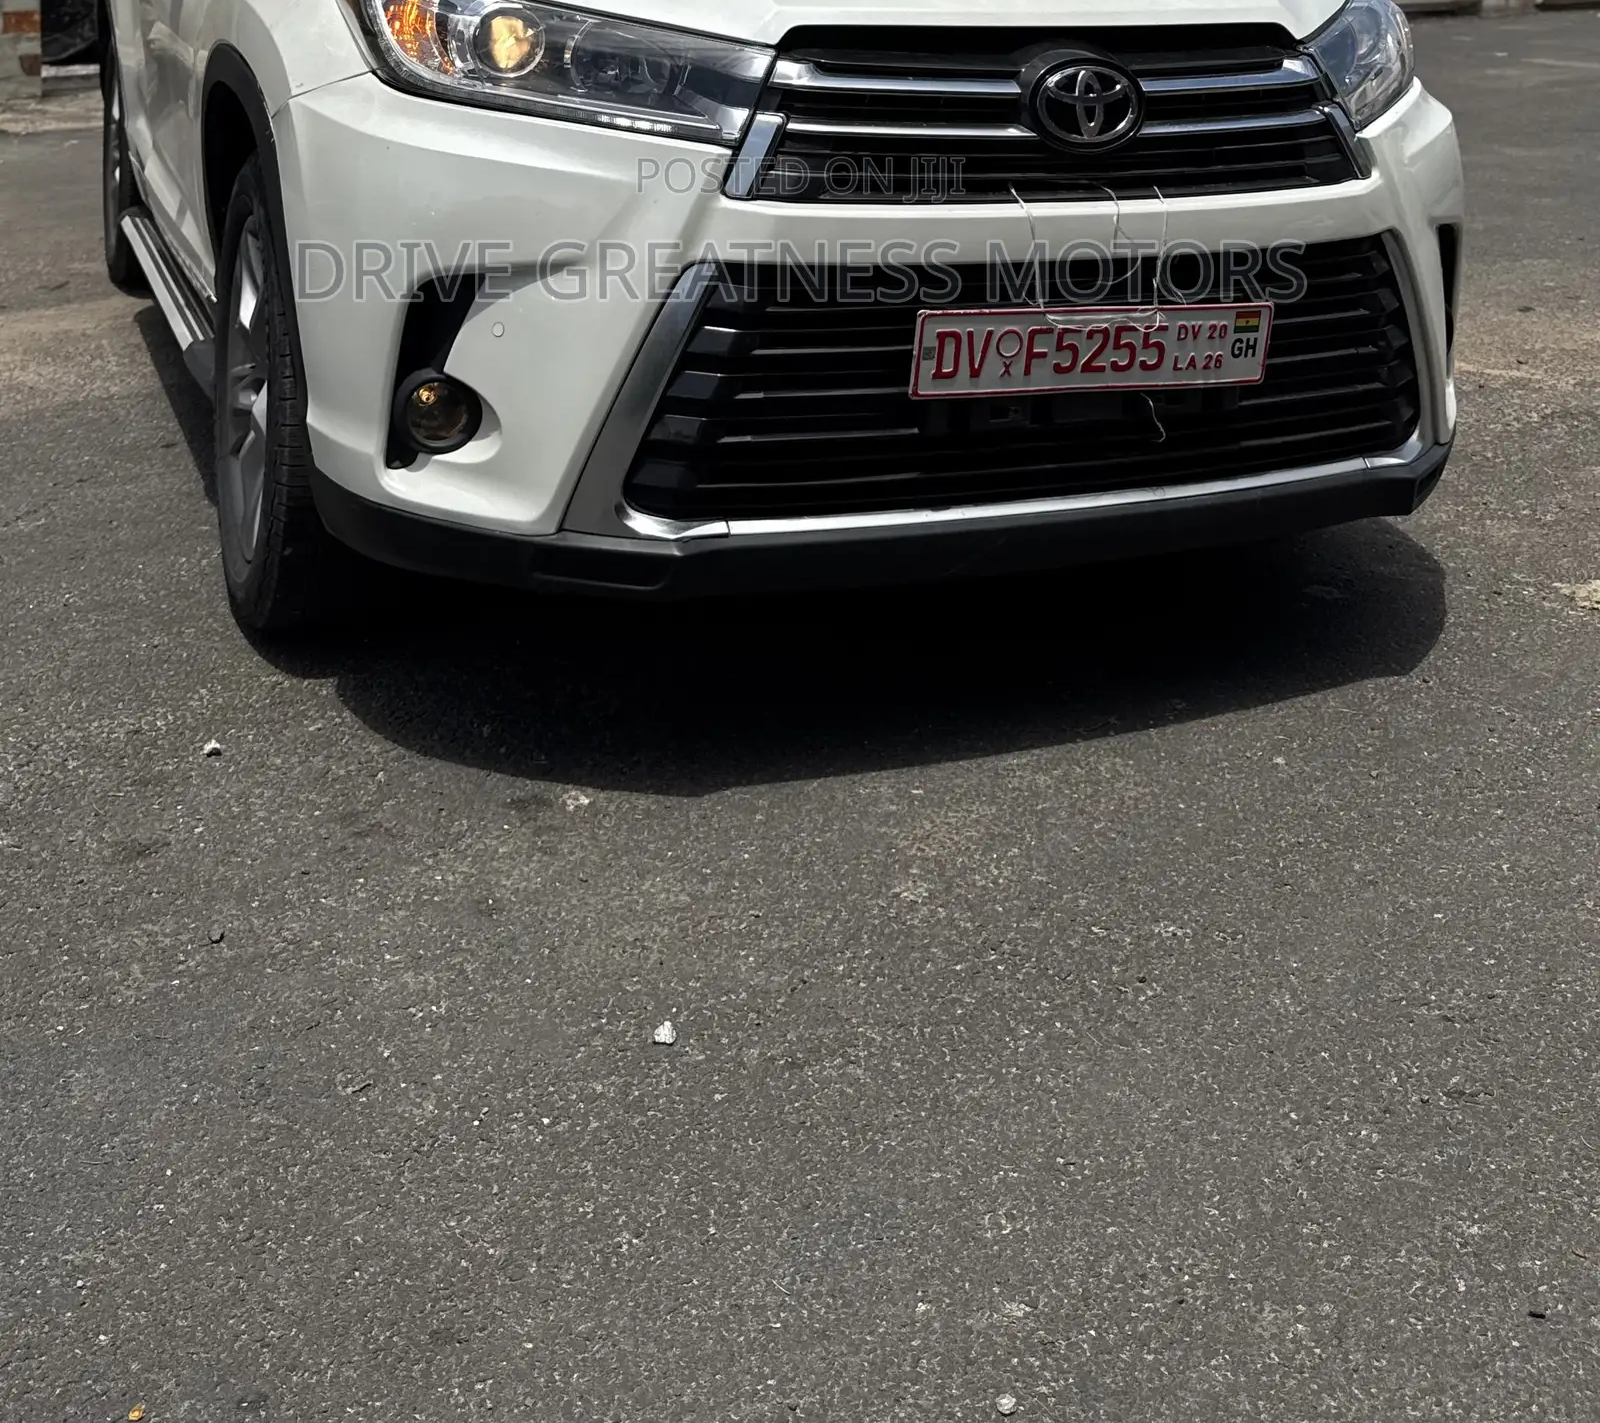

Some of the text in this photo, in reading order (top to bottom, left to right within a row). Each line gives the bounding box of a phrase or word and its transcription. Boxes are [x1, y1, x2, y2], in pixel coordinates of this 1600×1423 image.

[1176, 321, 1228, 341] DV 20
[1231, 337, 1258, 359] GH
[1172, 351, 1224, 371] LA 26
